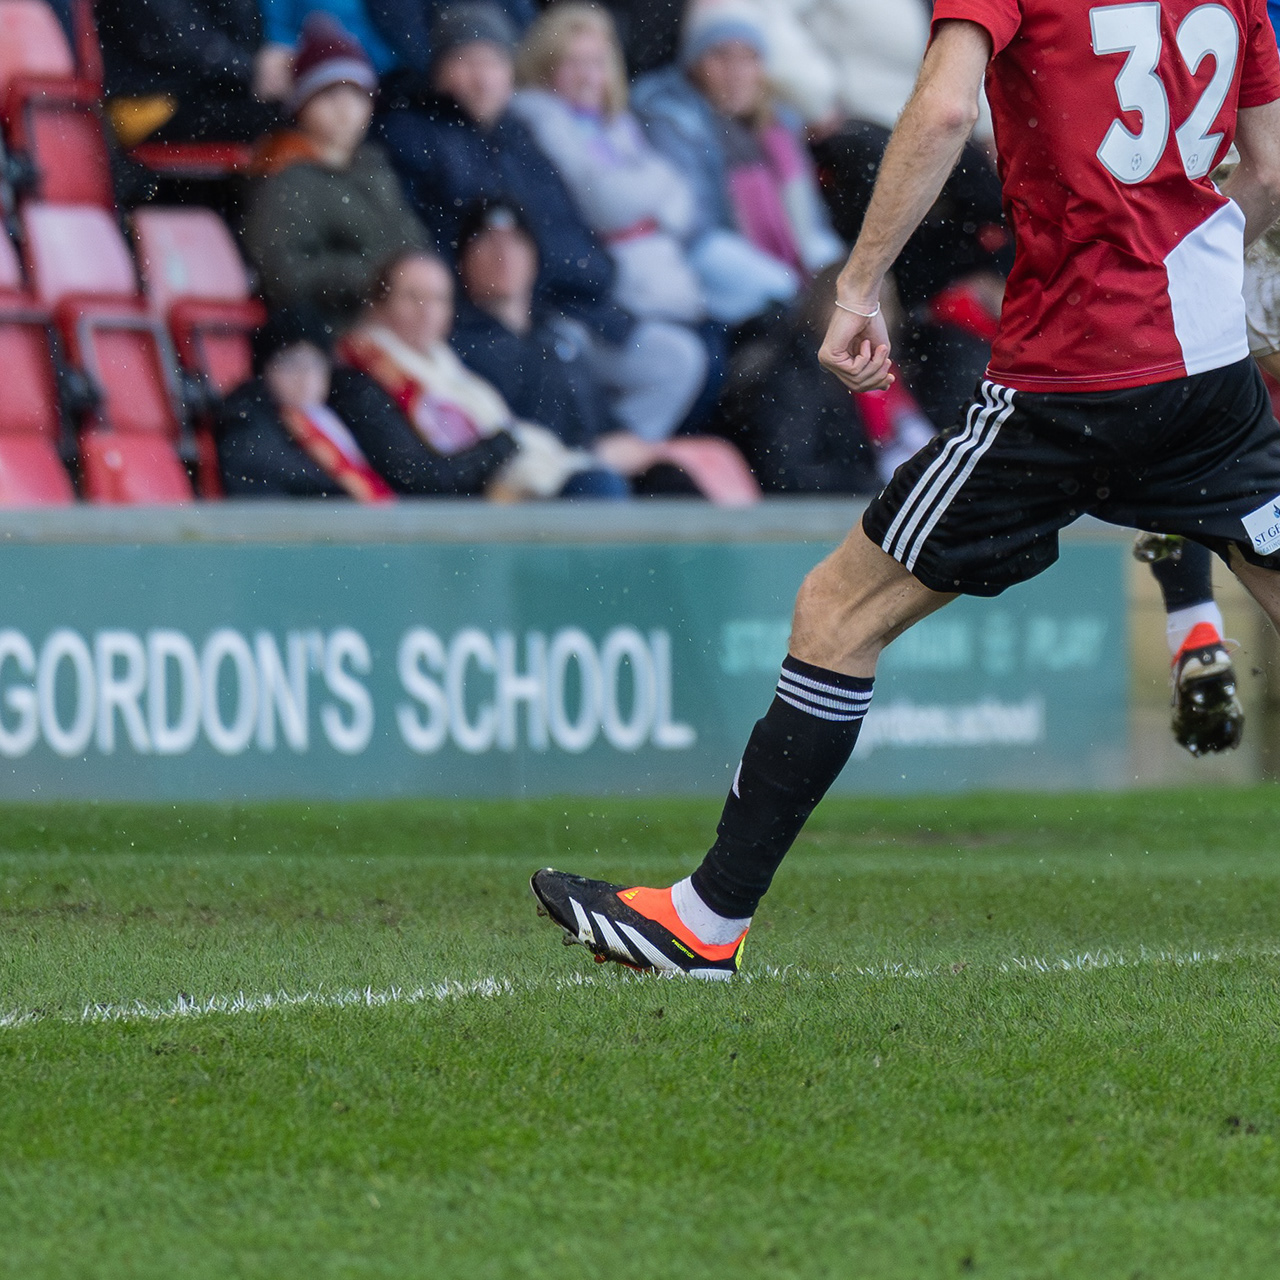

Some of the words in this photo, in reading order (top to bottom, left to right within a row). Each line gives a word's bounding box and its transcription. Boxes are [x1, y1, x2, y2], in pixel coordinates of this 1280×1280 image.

[1088, 1, 1239, 185] 32
[1254, 531, 1267, 547] ST
[395, 625, 697, 754] SCHOOL
